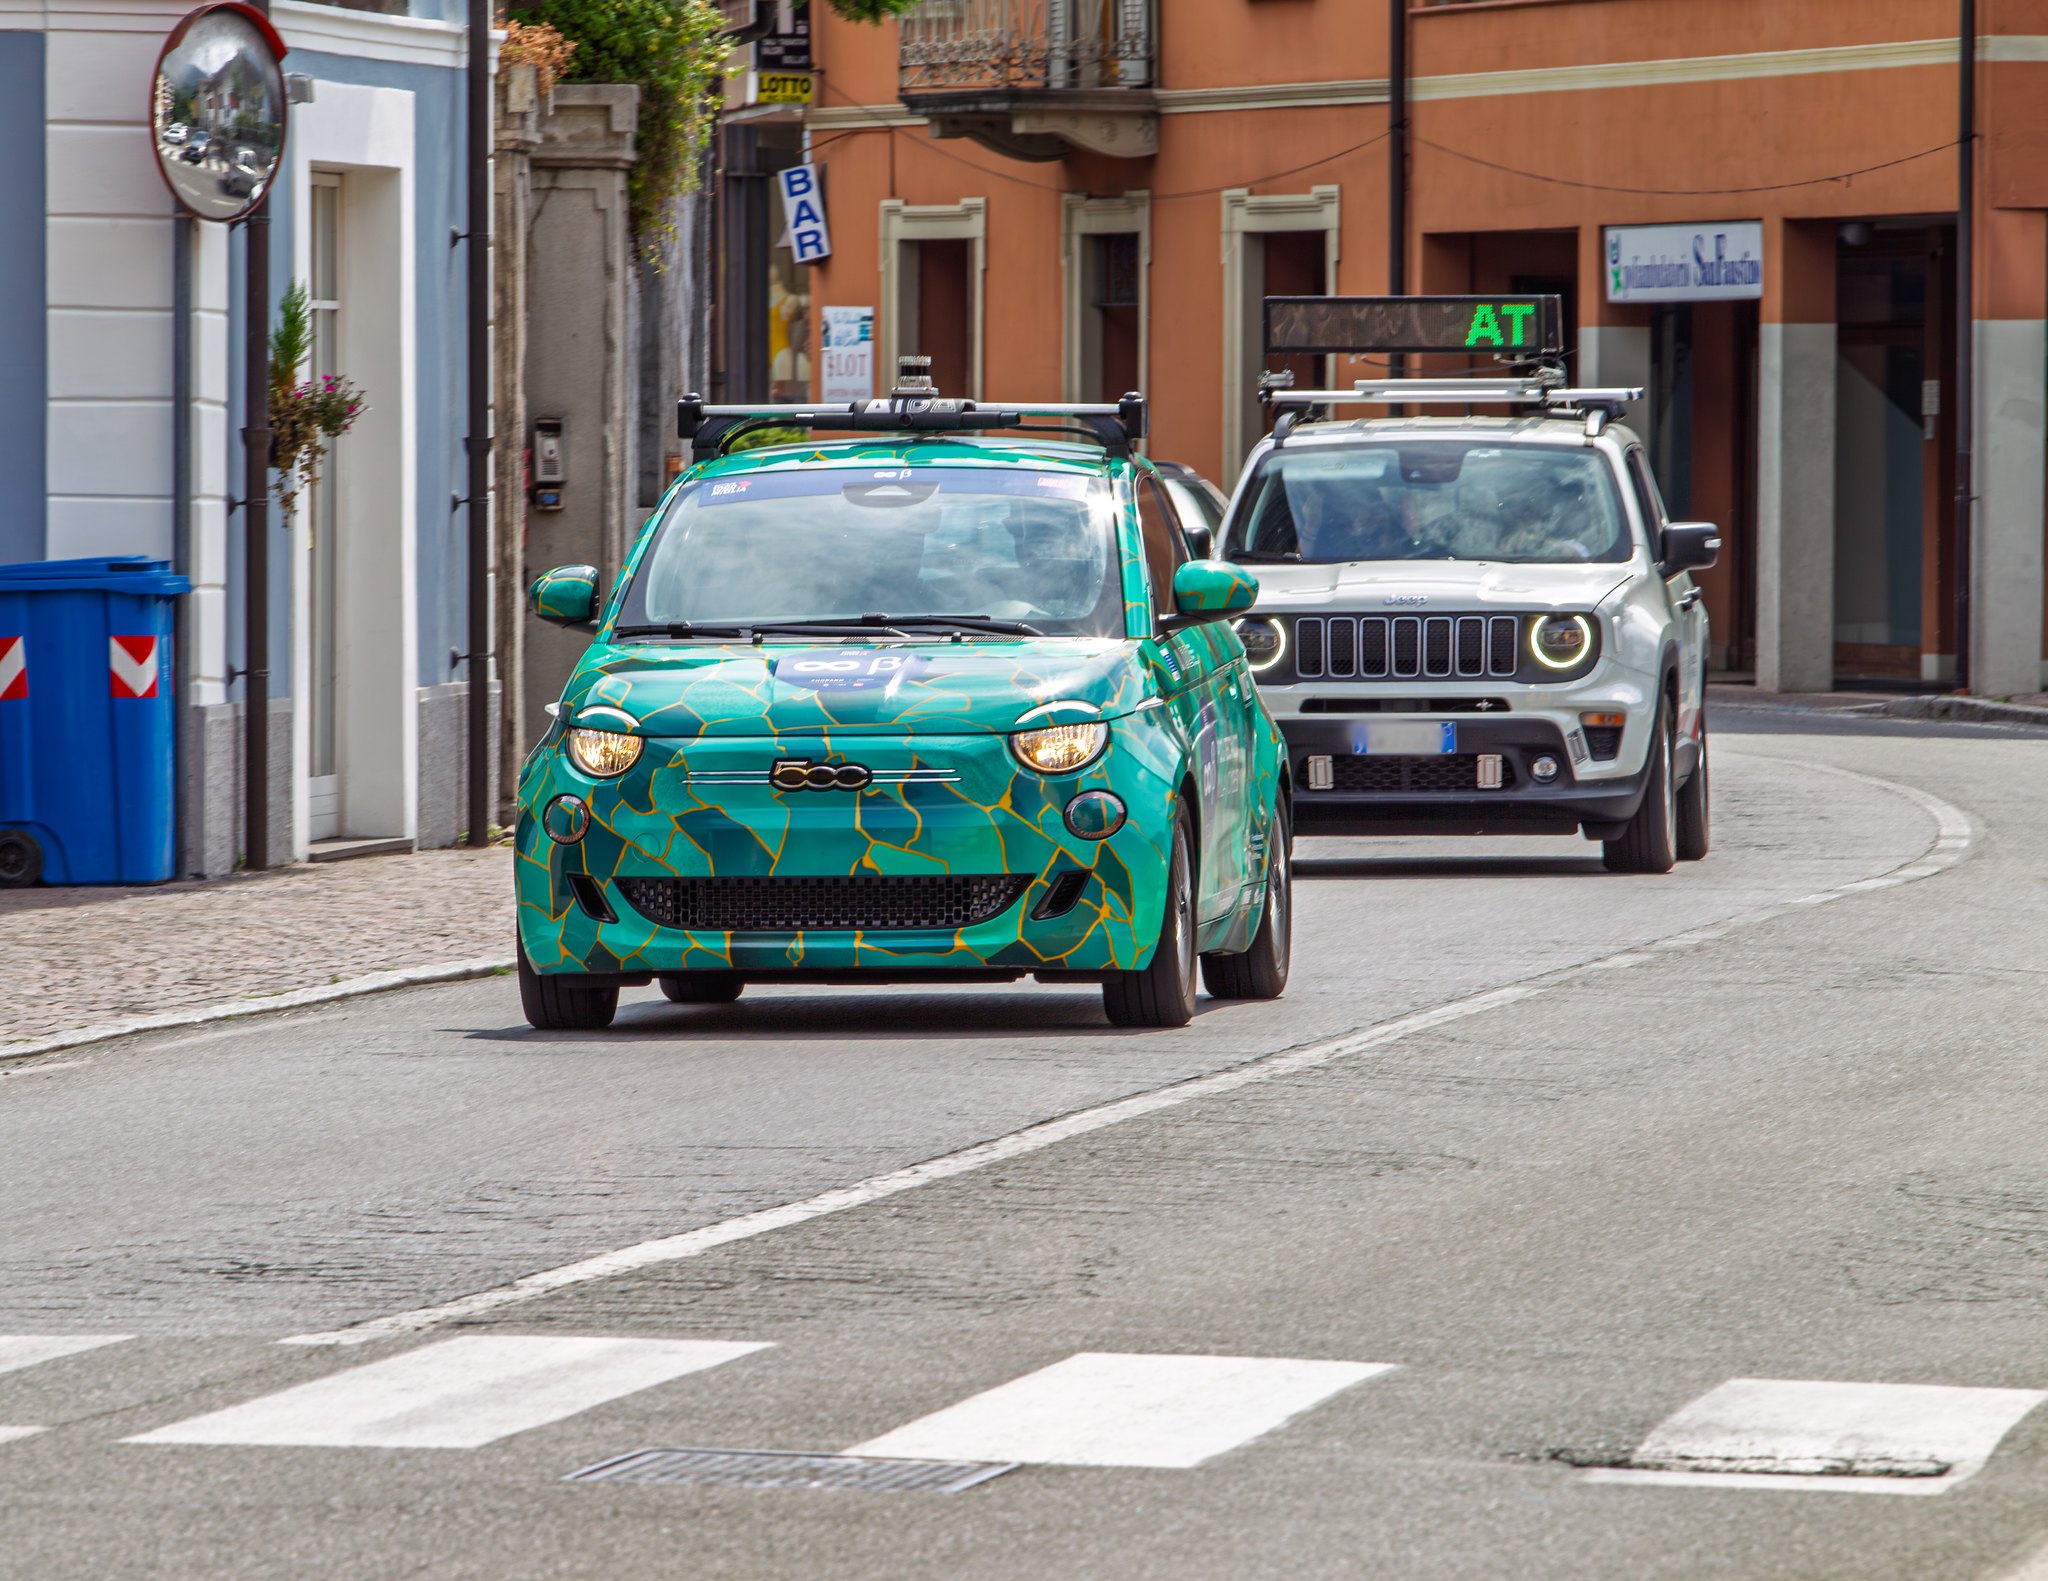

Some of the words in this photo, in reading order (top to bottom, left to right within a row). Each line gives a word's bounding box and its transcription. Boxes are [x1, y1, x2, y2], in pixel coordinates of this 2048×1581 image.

[759, 77, 811, 94] LOTTO
[784, 168, 825, 259] BAR
[1465, 304, 1535, 347] AT
[1383, 594, 1429, 607] Jeep
[773, 761, 869, 788] 500
